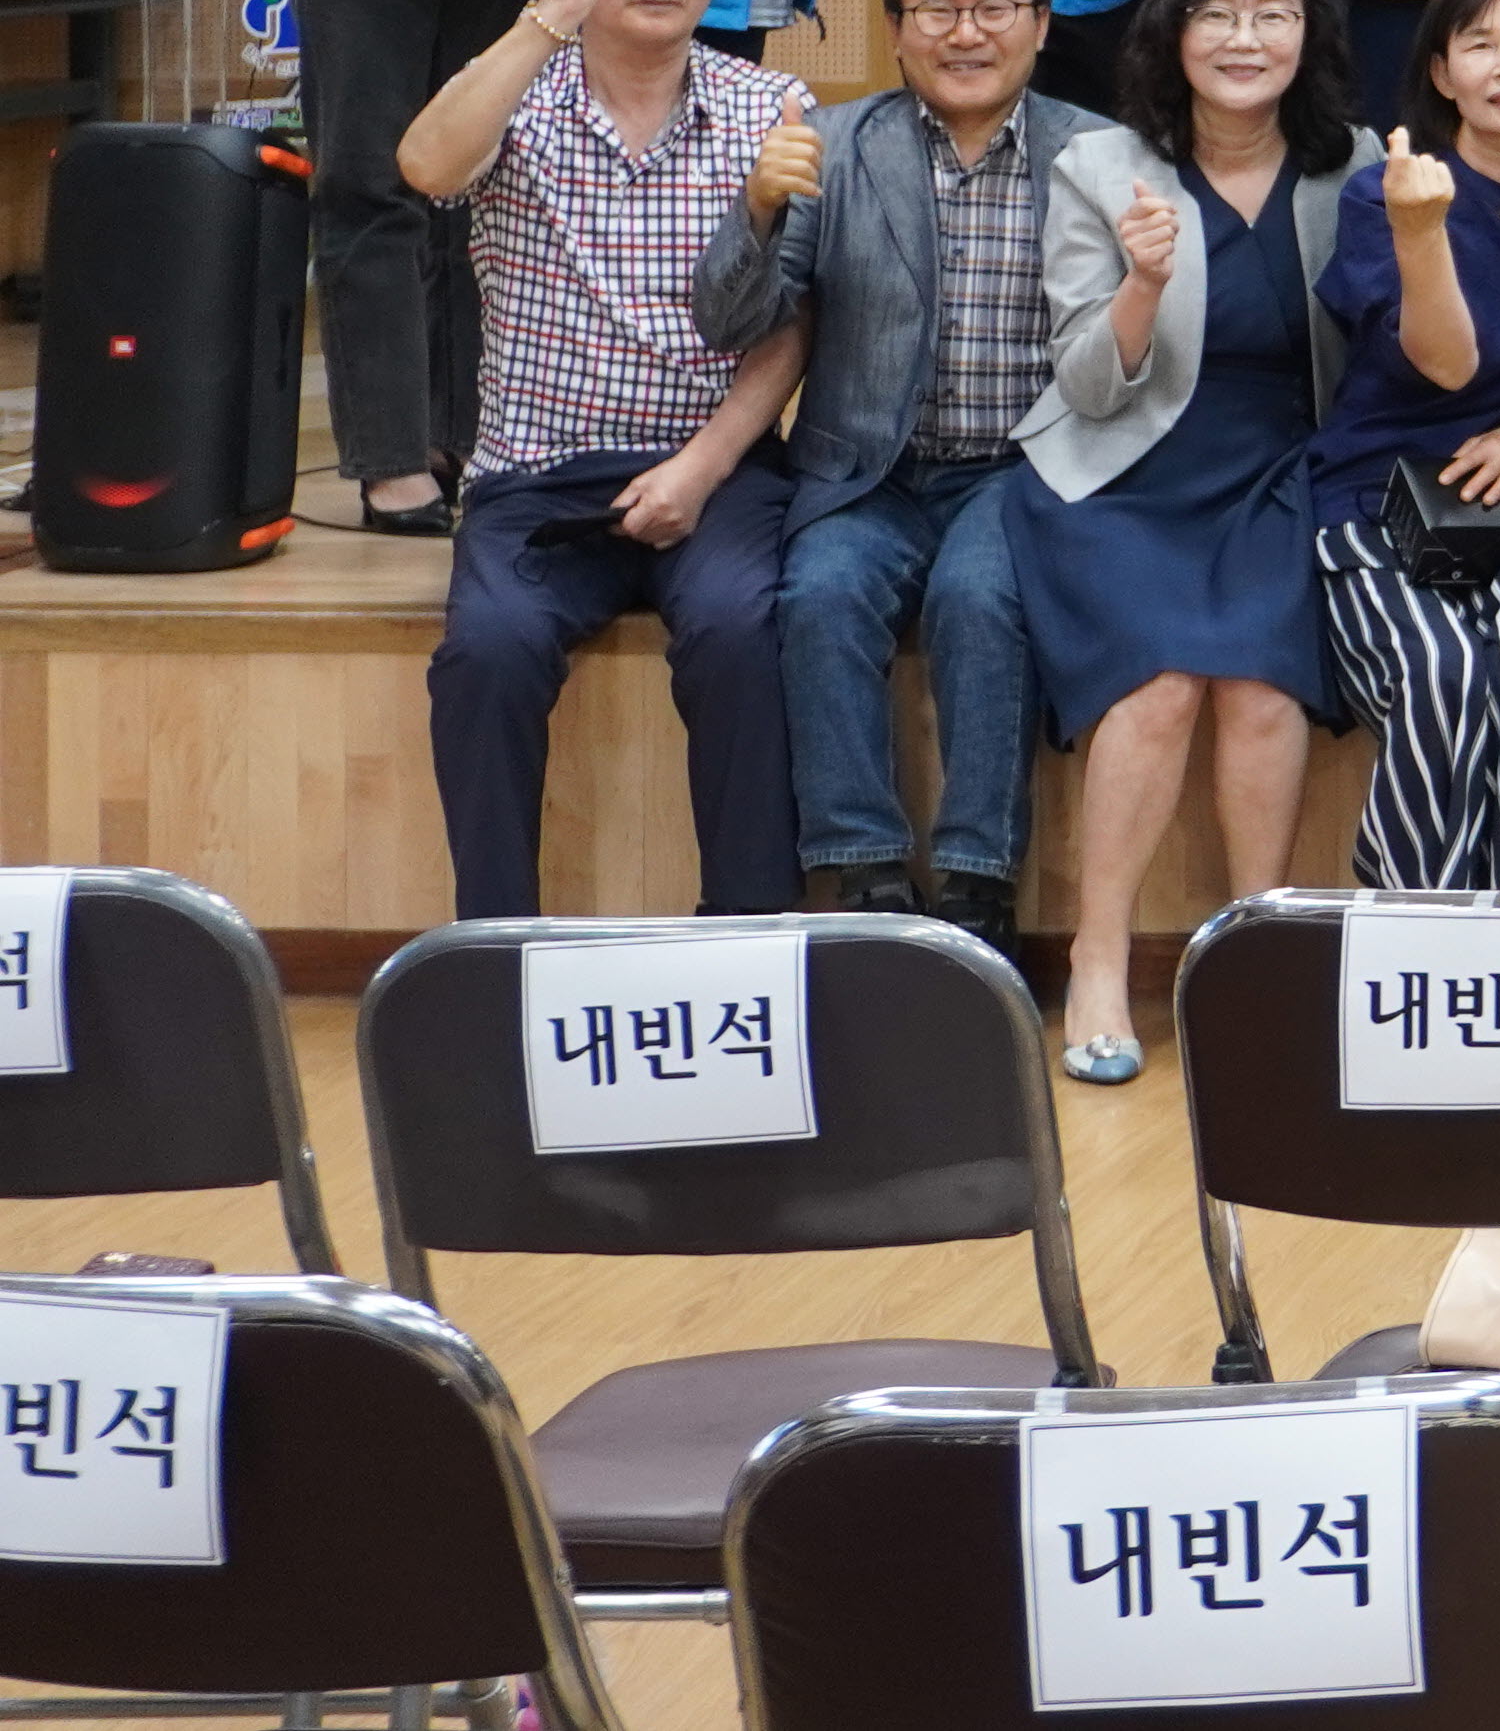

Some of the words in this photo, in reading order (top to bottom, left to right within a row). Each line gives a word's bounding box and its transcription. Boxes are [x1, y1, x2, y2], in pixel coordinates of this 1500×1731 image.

[549, 997, 773, 1086] 내빈석
[2, 1379, 176, 1488] 빈석
[1060, 1495, 1369, 1617] 내빈석
